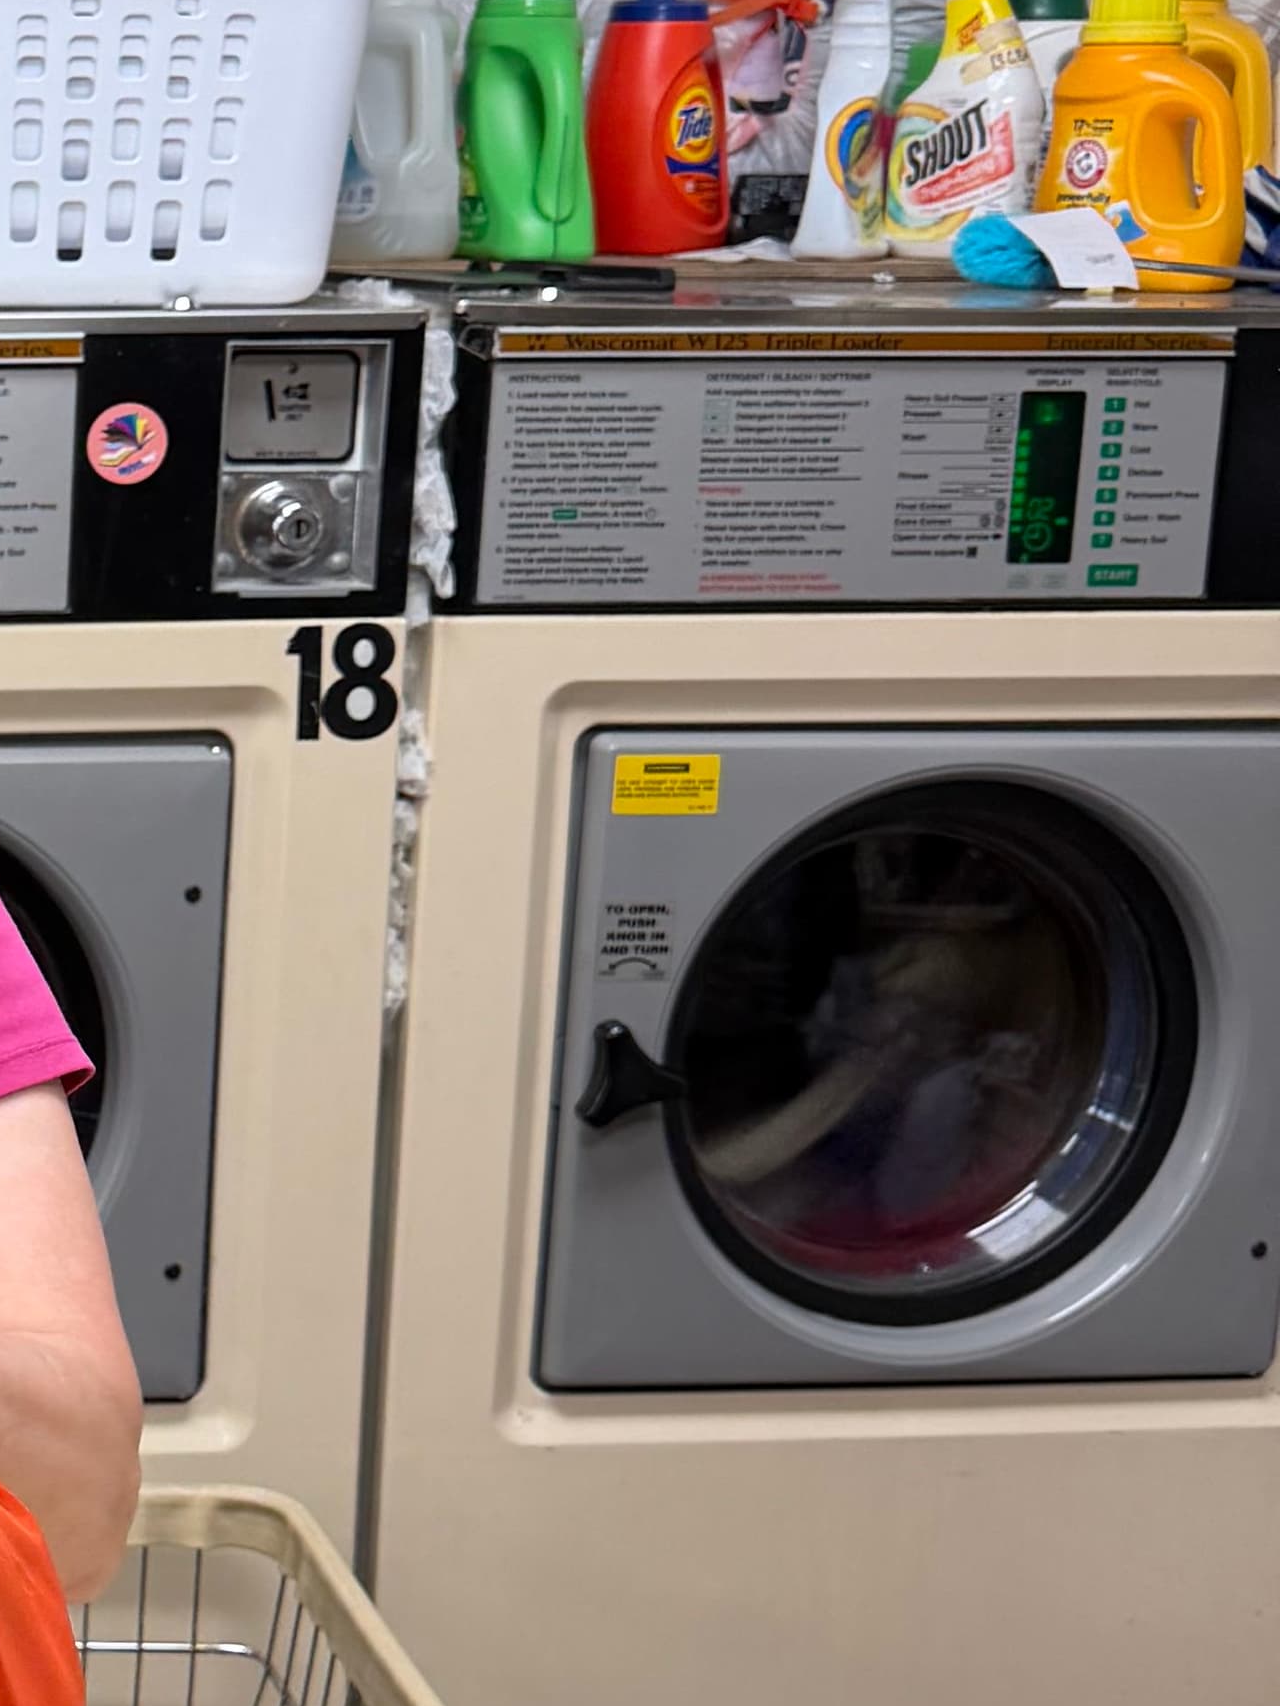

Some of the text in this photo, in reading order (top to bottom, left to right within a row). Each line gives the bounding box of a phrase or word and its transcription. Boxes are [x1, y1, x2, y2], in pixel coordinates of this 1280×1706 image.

[677, 106, 713, 148] Tide
[906, 98, 988, 187] SHOUT
[566, 334, 675, 351] Wascomat
[762, 334, 823, 352] Triple
[834, 334, 904, 351] Loader
[1046, 333, 1136, 351] Emerald
[1145, 334, 1209, 351] Series
[13, 525, 38, 534] Wash
[1093, 569, 1133, 581] START
[285, 623, 399, 741] 18
[605, 904, 624, 914] TO
[618, 918, 656, 928] PUSH
[607, 931, 665, 941] KNOB IN
[601, 945, 669, 955] AND TURN
